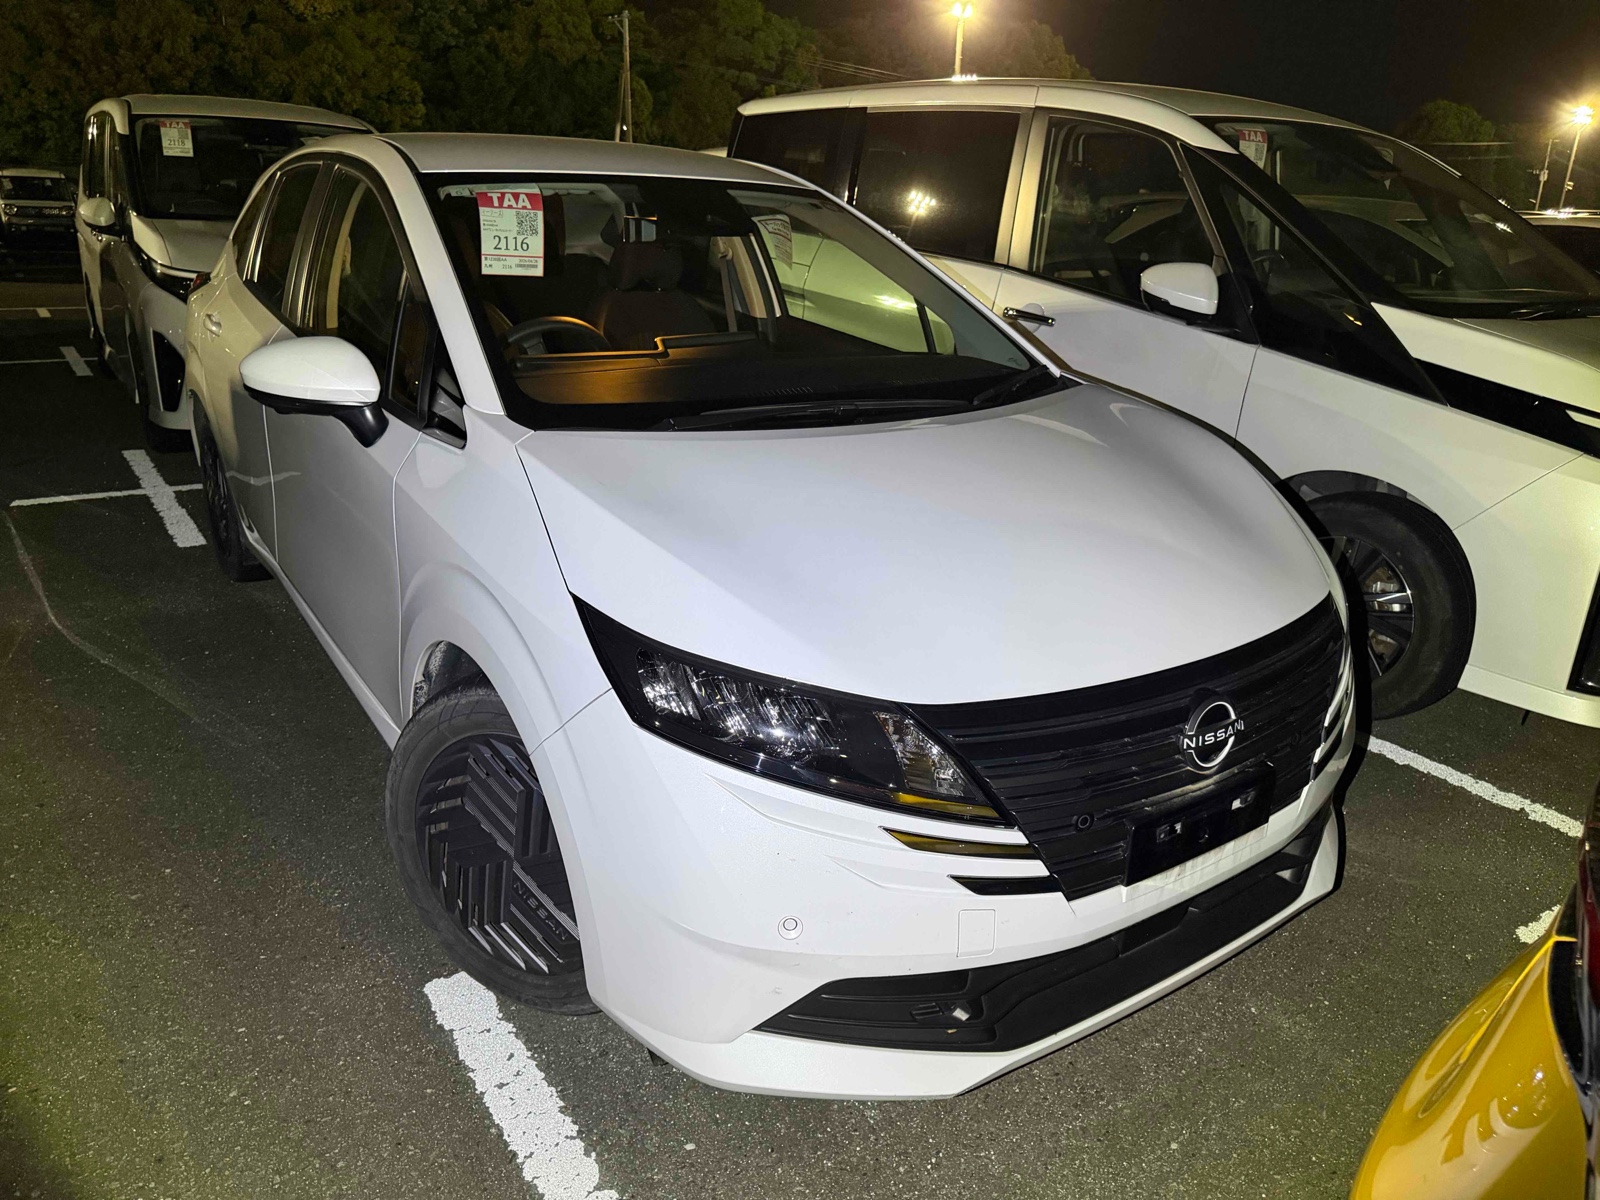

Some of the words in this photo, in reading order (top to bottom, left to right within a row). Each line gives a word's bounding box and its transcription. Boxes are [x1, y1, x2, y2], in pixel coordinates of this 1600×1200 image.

[165, 121, 186, 129] TAA
[167, 138, 186, 147] 2118
[1242, 130, 1263, 143] TAA
[487, 192, 532, 209] TAA
[493, 234, 530, 252] 2116
[1183, 719, 1245, 749] NISSAN
[513, 881, 569, 940] NISSAN
